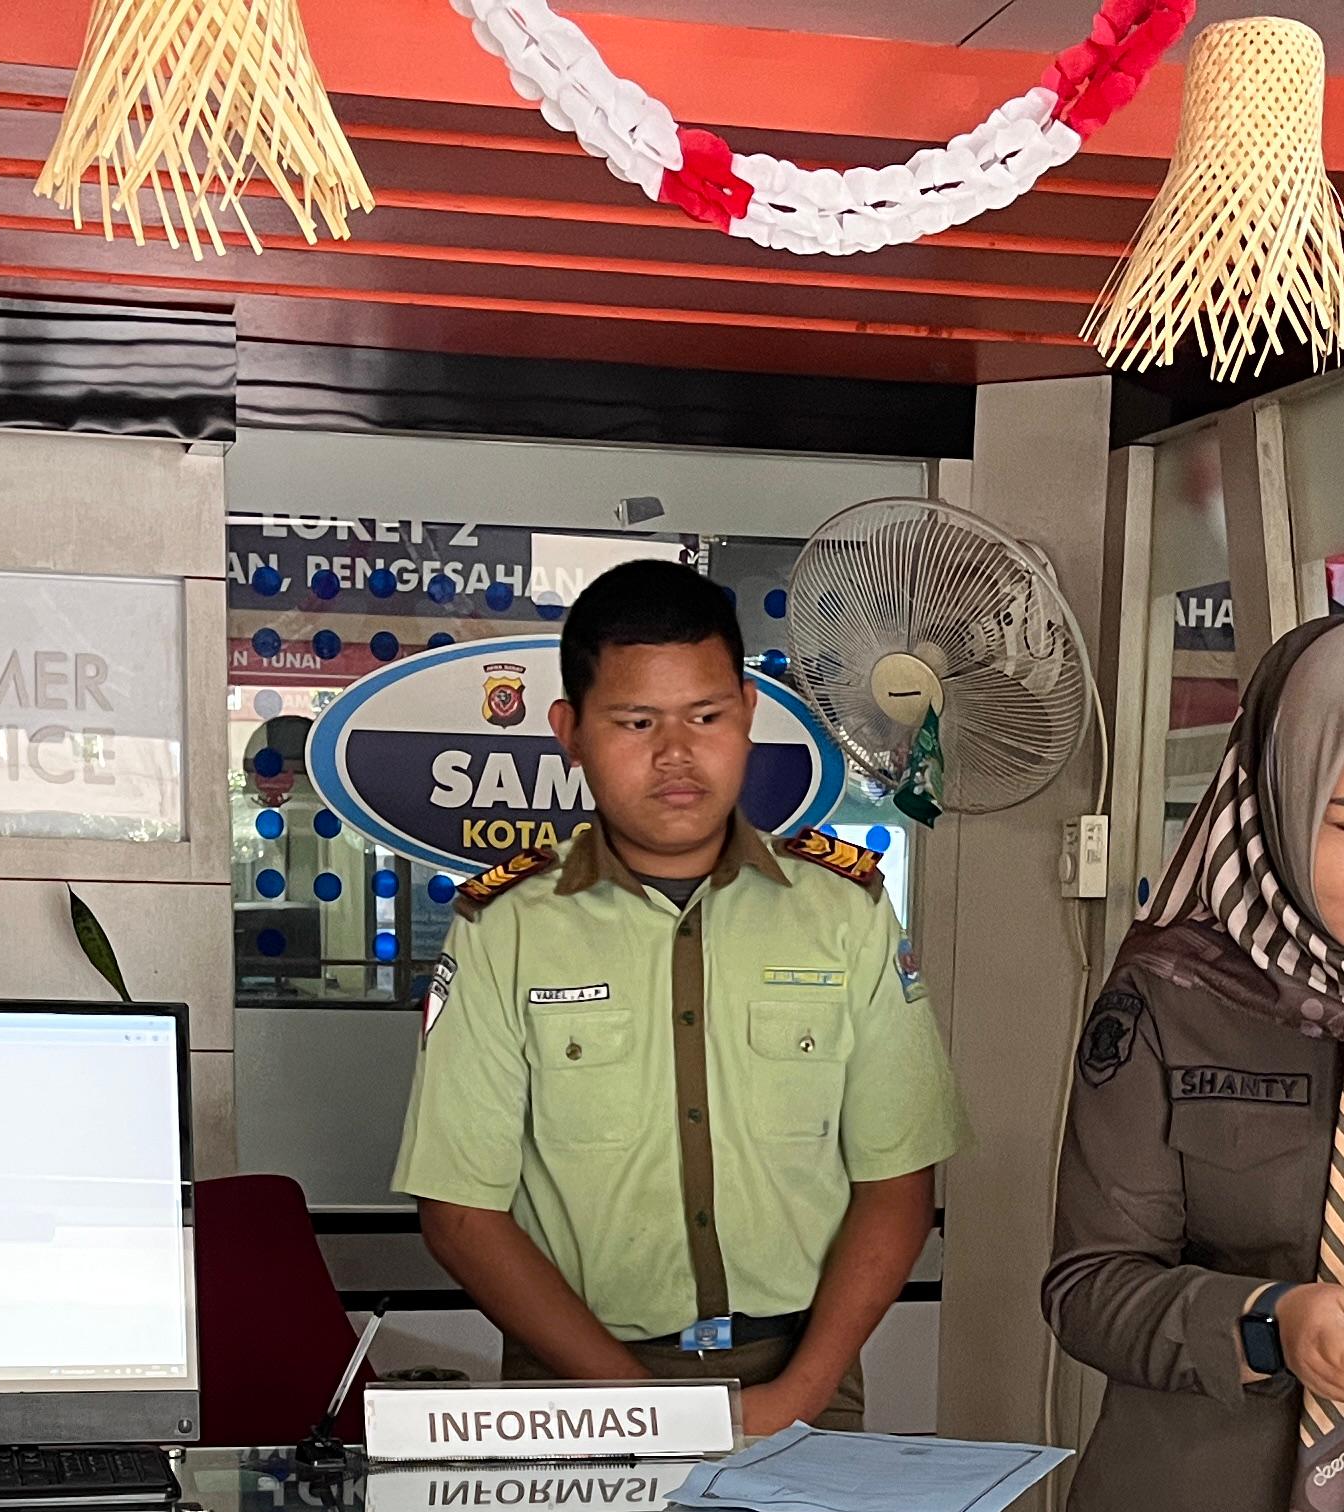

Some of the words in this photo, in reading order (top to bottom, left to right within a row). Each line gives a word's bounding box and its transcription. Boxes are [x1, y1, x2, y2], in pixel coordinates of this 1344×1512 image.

[430, 750, 596, 811] SAM
[462, 819, 558, 850] KOTA
[1181, 1069, 1297, 1099] SHANTY
[428, 1406, 660, 1444] INFORMASI
